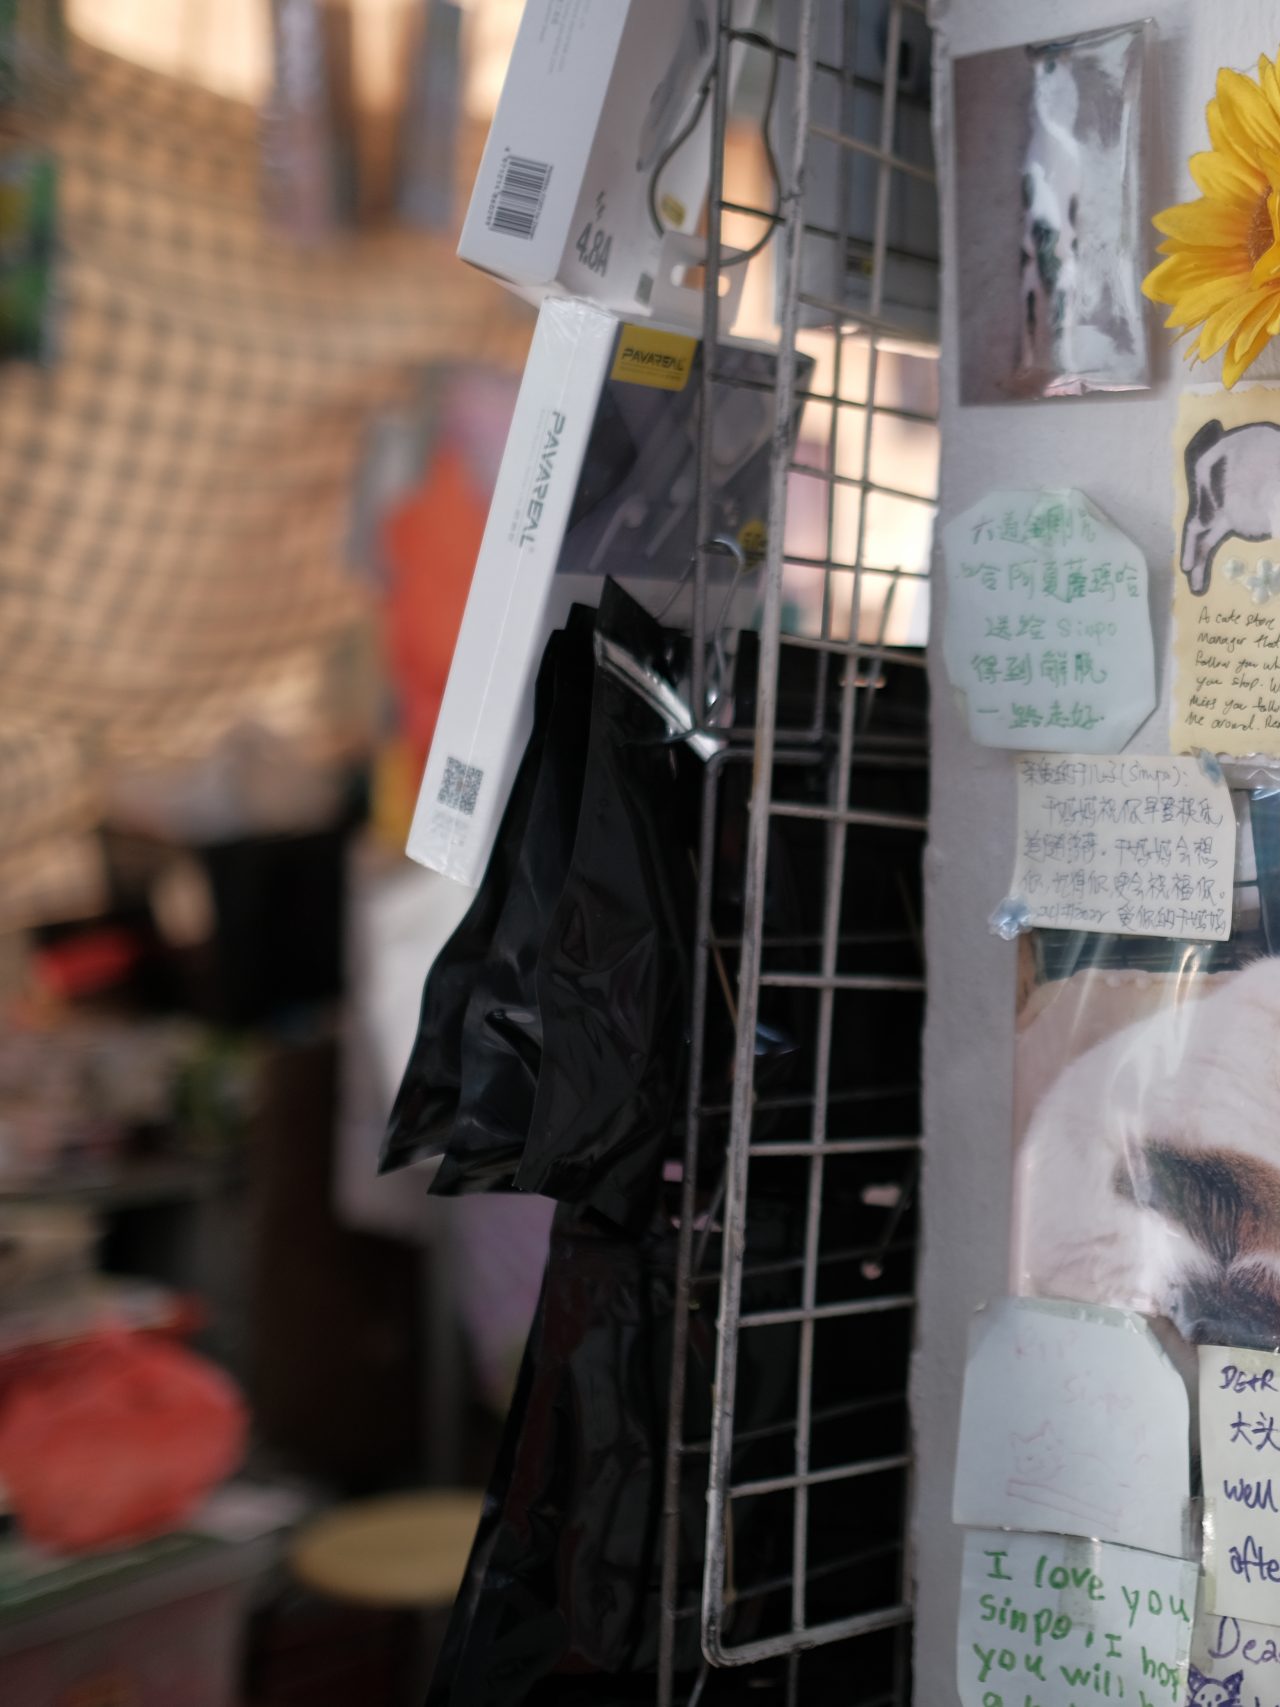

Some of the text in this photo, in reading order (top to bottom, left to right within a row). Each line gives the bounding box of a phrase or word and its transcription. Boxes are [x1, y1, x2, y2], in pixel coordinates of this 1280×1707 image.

[575, 221, 614, 278] 4.8A
[621, 347, 684, 372] PAVAREAL
[517, 410, 567, 549] PAVAREAL
[1223, 1478, 1279, 1513] well
[983, 1550, 1190, 1629] I love you
[972, 1643, 1047, 1683] you
[1059, 1662, 1125, 1699] will
[1104, 1633, 1123, 1659] I
